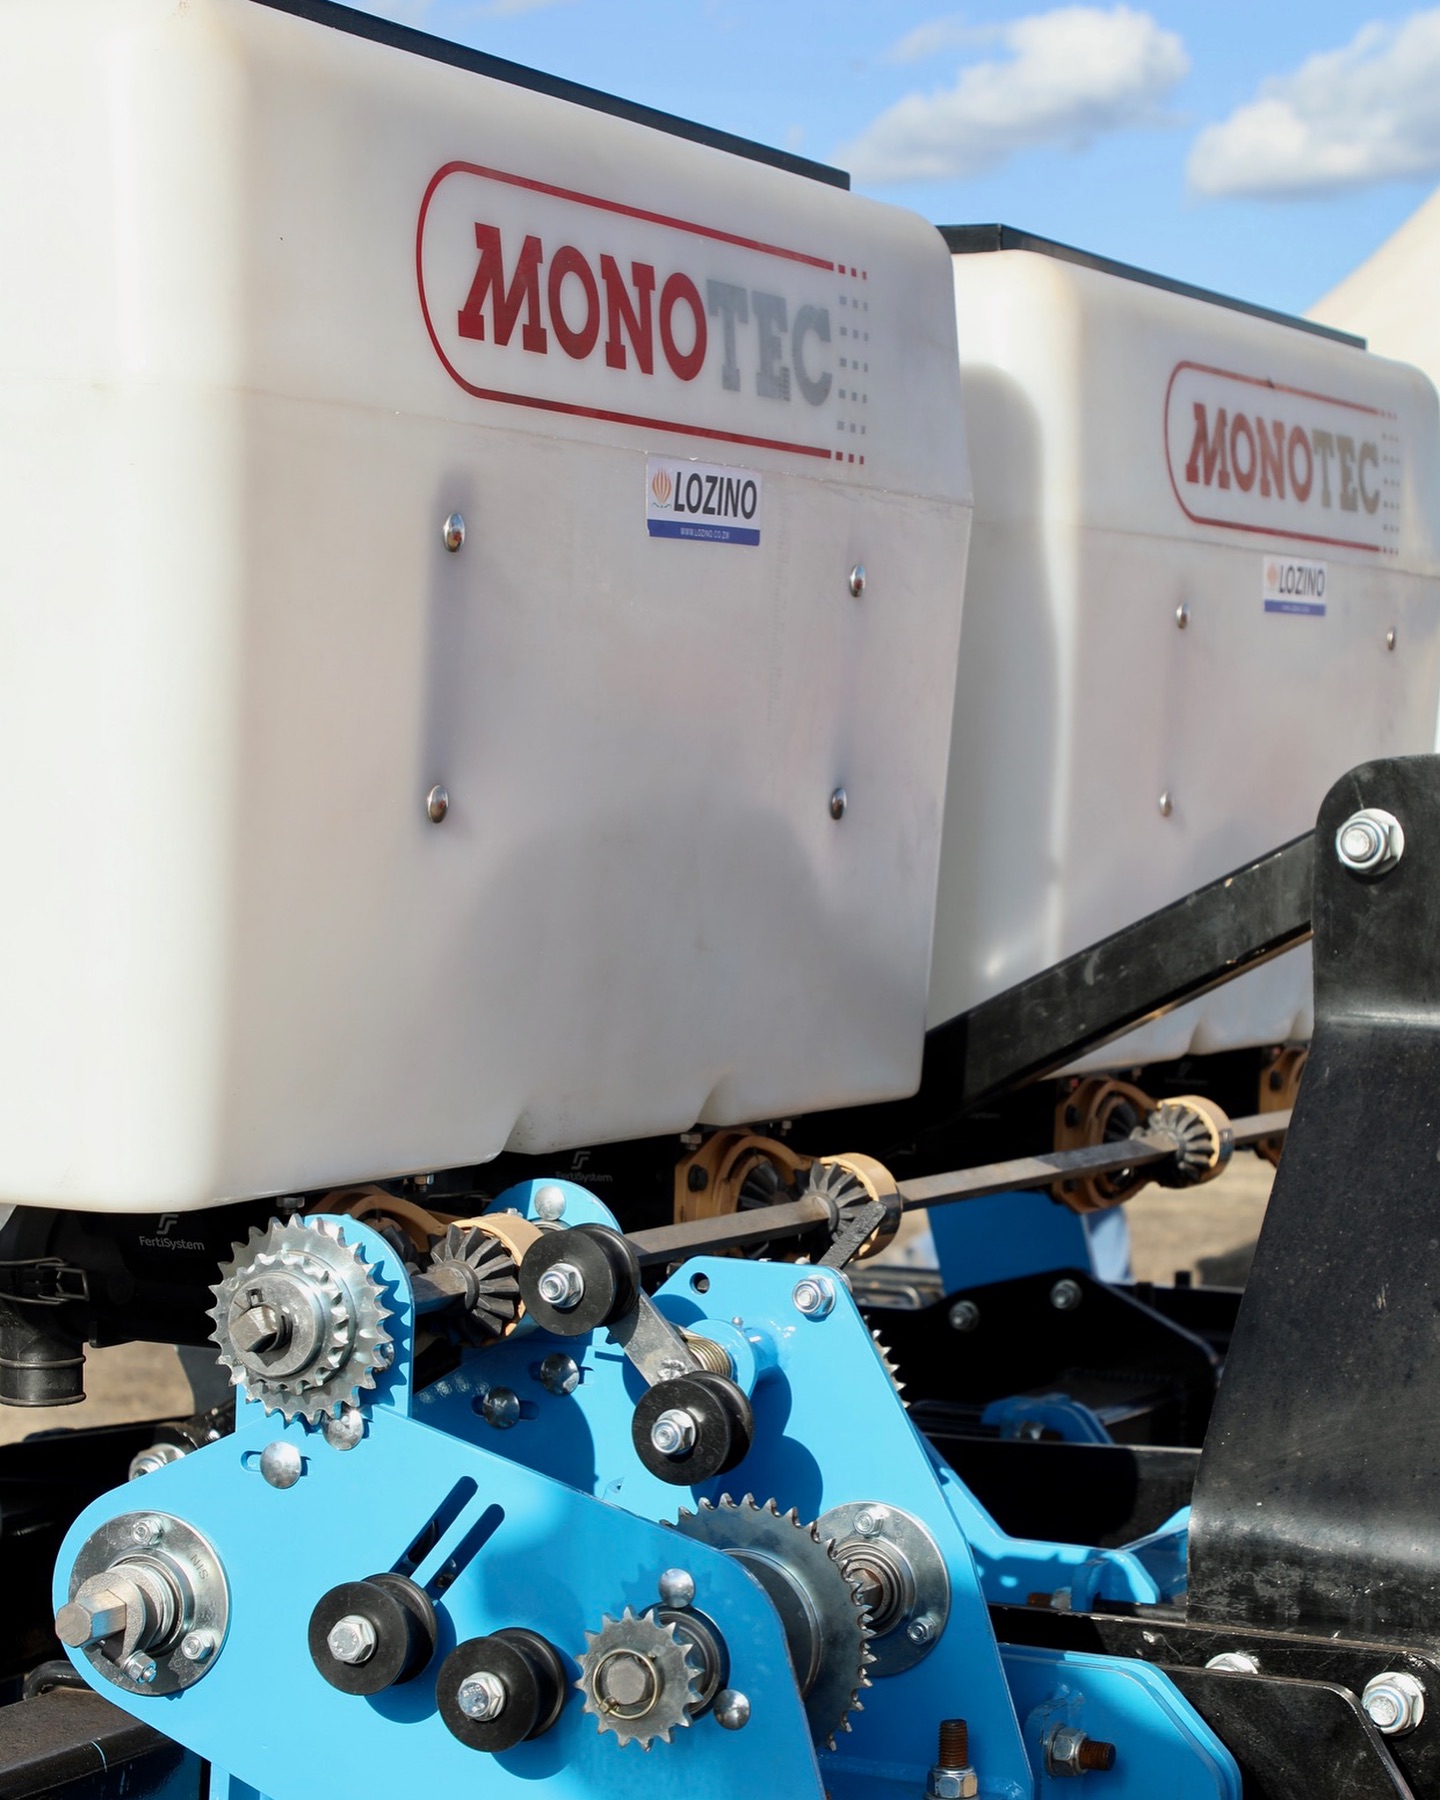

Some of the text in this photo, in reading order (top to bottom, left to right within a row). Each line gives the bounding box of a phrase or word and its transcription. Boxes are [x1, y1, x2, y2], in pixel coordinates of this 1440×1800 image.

[458, 222, 833, 407] MONOTEC
[1185, 402, 1380, 515] MONOTEC
[674, 471, 757, 520] LOZINO
[1279, 565, 1325, 597] LOZINO
[139, 1236, 205, 1250] FertiSystem
